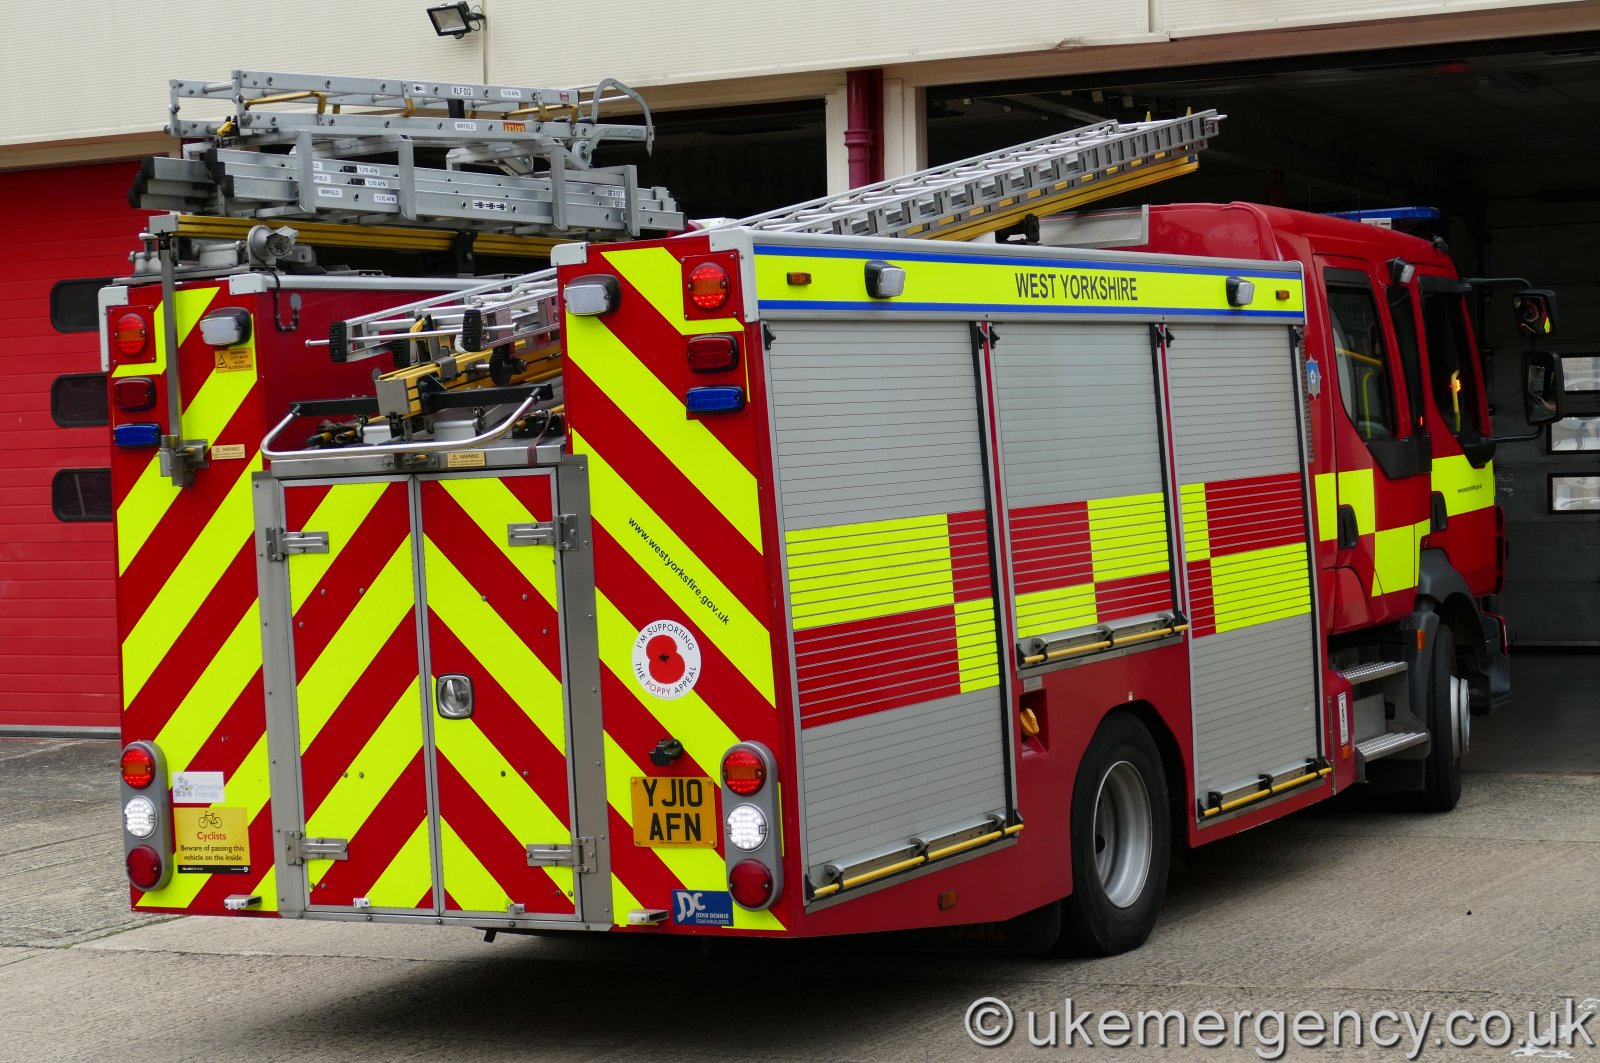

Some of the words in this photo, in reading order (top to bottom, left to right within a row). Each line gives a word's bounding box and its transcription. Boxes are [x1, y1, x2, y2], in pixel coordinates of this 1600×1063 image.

[1014, 272, 1056, 299] WEST
[1060, 274, 1139, 301] YORKSHIRE
[628, 517, 730, 626] www.westyorksfire.gov.uk
[636, 634, 648, 649] I'M
[647, 623, 695, 651] SUPPORTING
[635, 662, 646, 680] THE
[645, 680, 671, 696] POPPY
[674, 666, 697, 695] APPEAL
[642, 778, 703, 808] YJ10
[196, 831, 227, 842] Cyclists
[649, 812, 702, 842] AFN
[203, 844, 210, 852] of
[211, 845, 233, 853] passing
[233, 844, 245, 852] this
